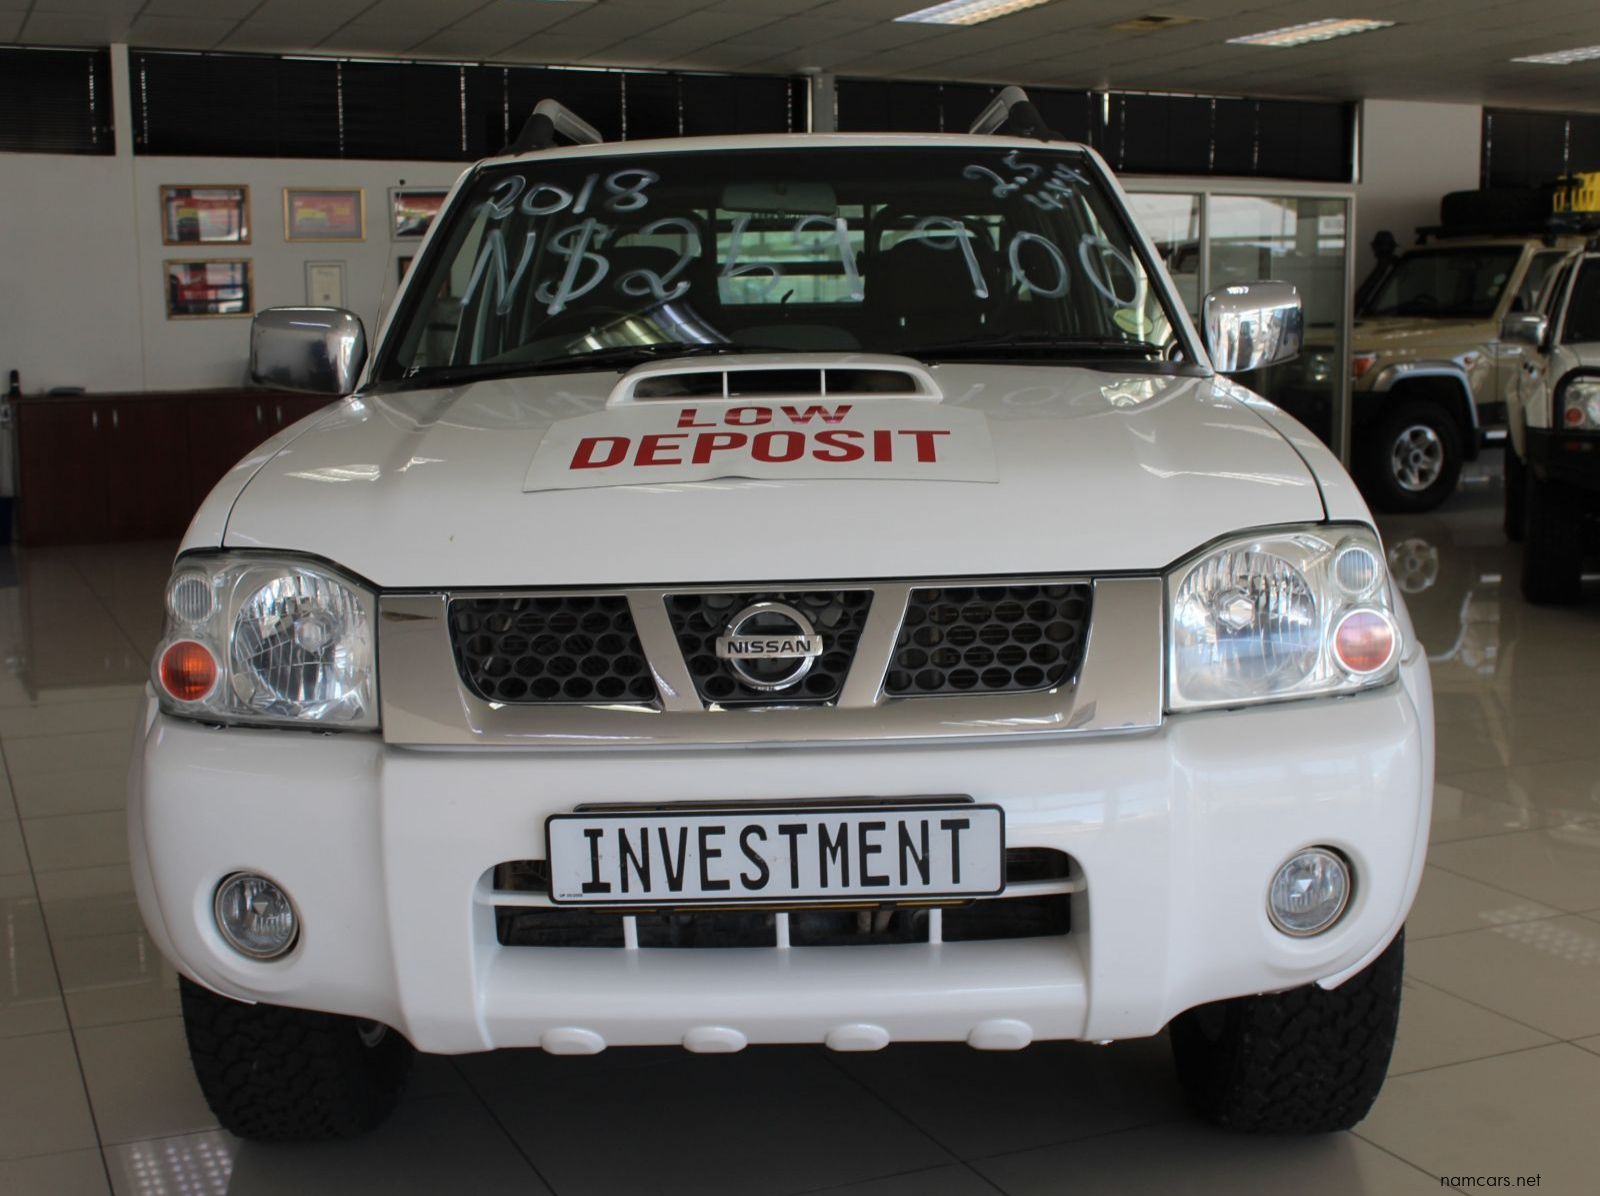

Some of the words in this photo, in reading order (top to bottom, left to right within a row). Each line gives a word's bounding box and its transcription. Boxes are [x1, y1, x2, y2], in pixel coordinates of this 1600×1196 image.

[473, 169, 660, 220] 2018
[676, 405, 853, 428] LOW
[568, 429, 952, 470] DEPOSIT
[727, 640, 811, 654] NISSAN
[583, 819, 970, 893] INVESTMENT
